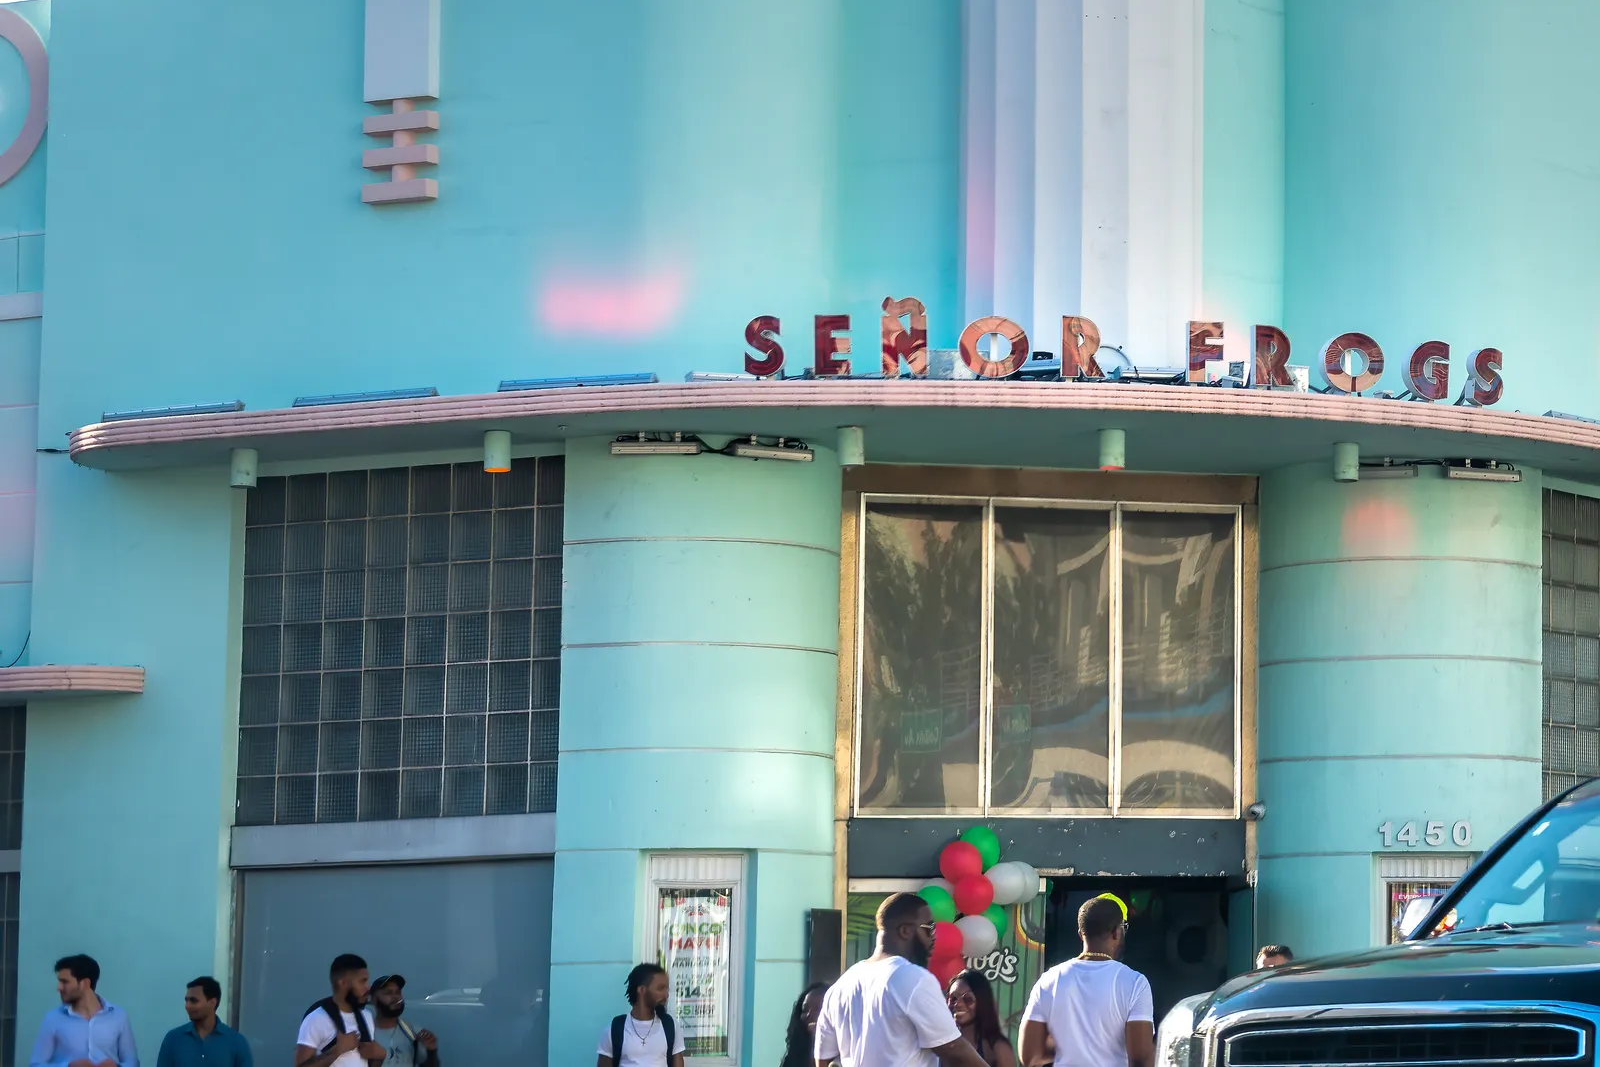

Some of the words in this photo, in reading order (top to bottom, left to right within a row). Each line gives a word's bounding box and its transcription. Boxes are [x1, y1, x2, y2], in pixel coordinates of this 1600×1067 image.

[744, 296, 1105, 380] SEÑOR
[1185, 321, 1505, 405] FROGS
[1378, 820, 1472, 847] 1450
